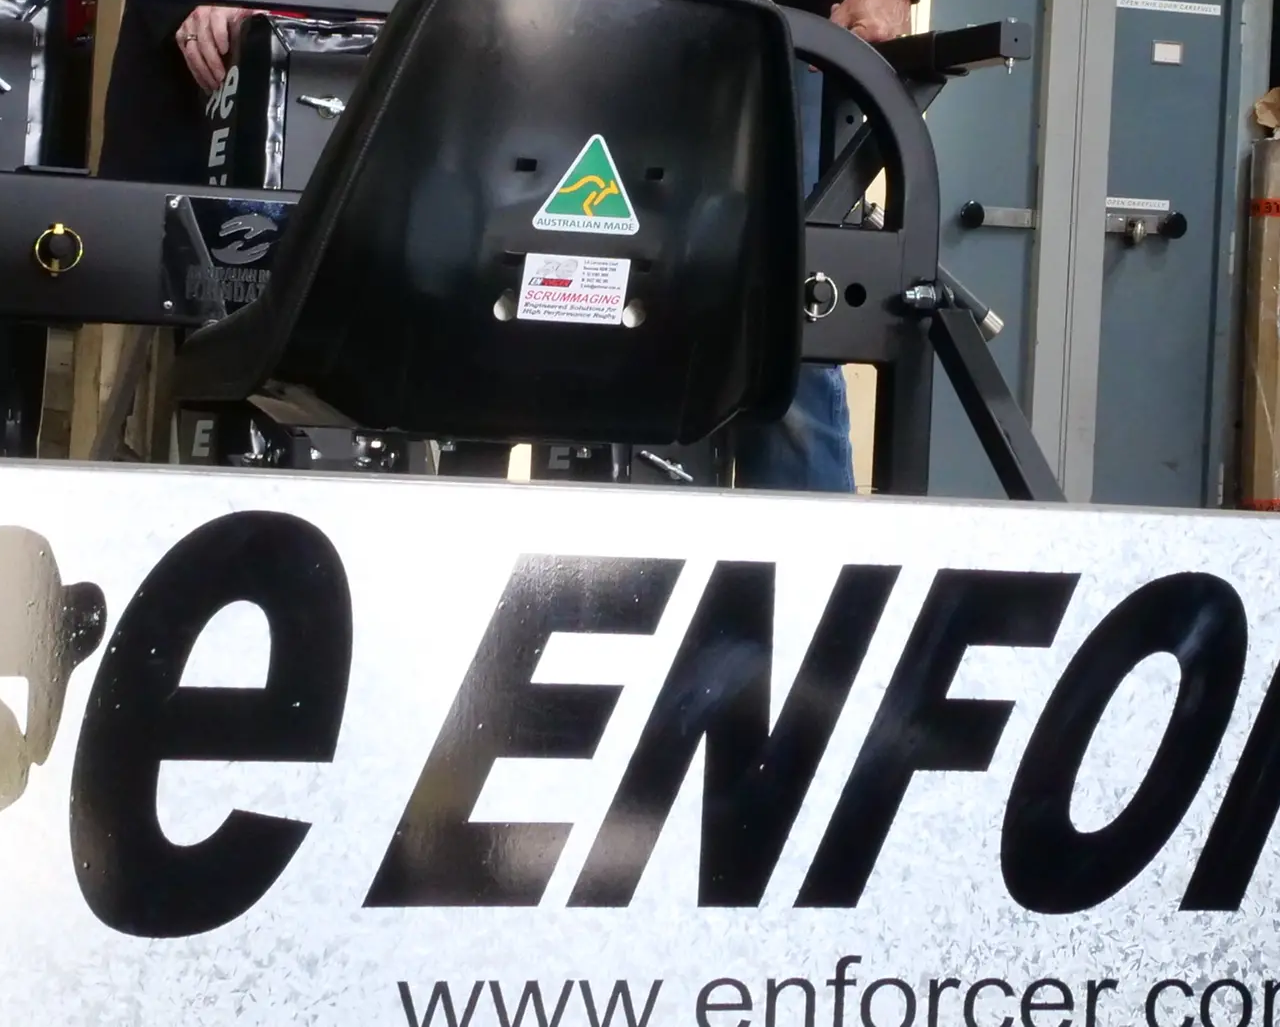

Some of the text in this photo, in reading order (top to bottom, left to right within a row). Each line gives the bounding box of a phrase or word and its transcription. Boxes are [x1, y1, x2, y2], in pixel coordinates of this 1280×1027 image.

[1179, 4, 1217, 12] CAREFULLY
[536, 217, 634, 231] AUSTRALIAN MADE
[524, 290, 621, 305] SCRUMMAGING
[524, 302, 568, 311] Engineered
[569, 304, 605, 312] Solutions
[543, 310, 591, 318] Performance
